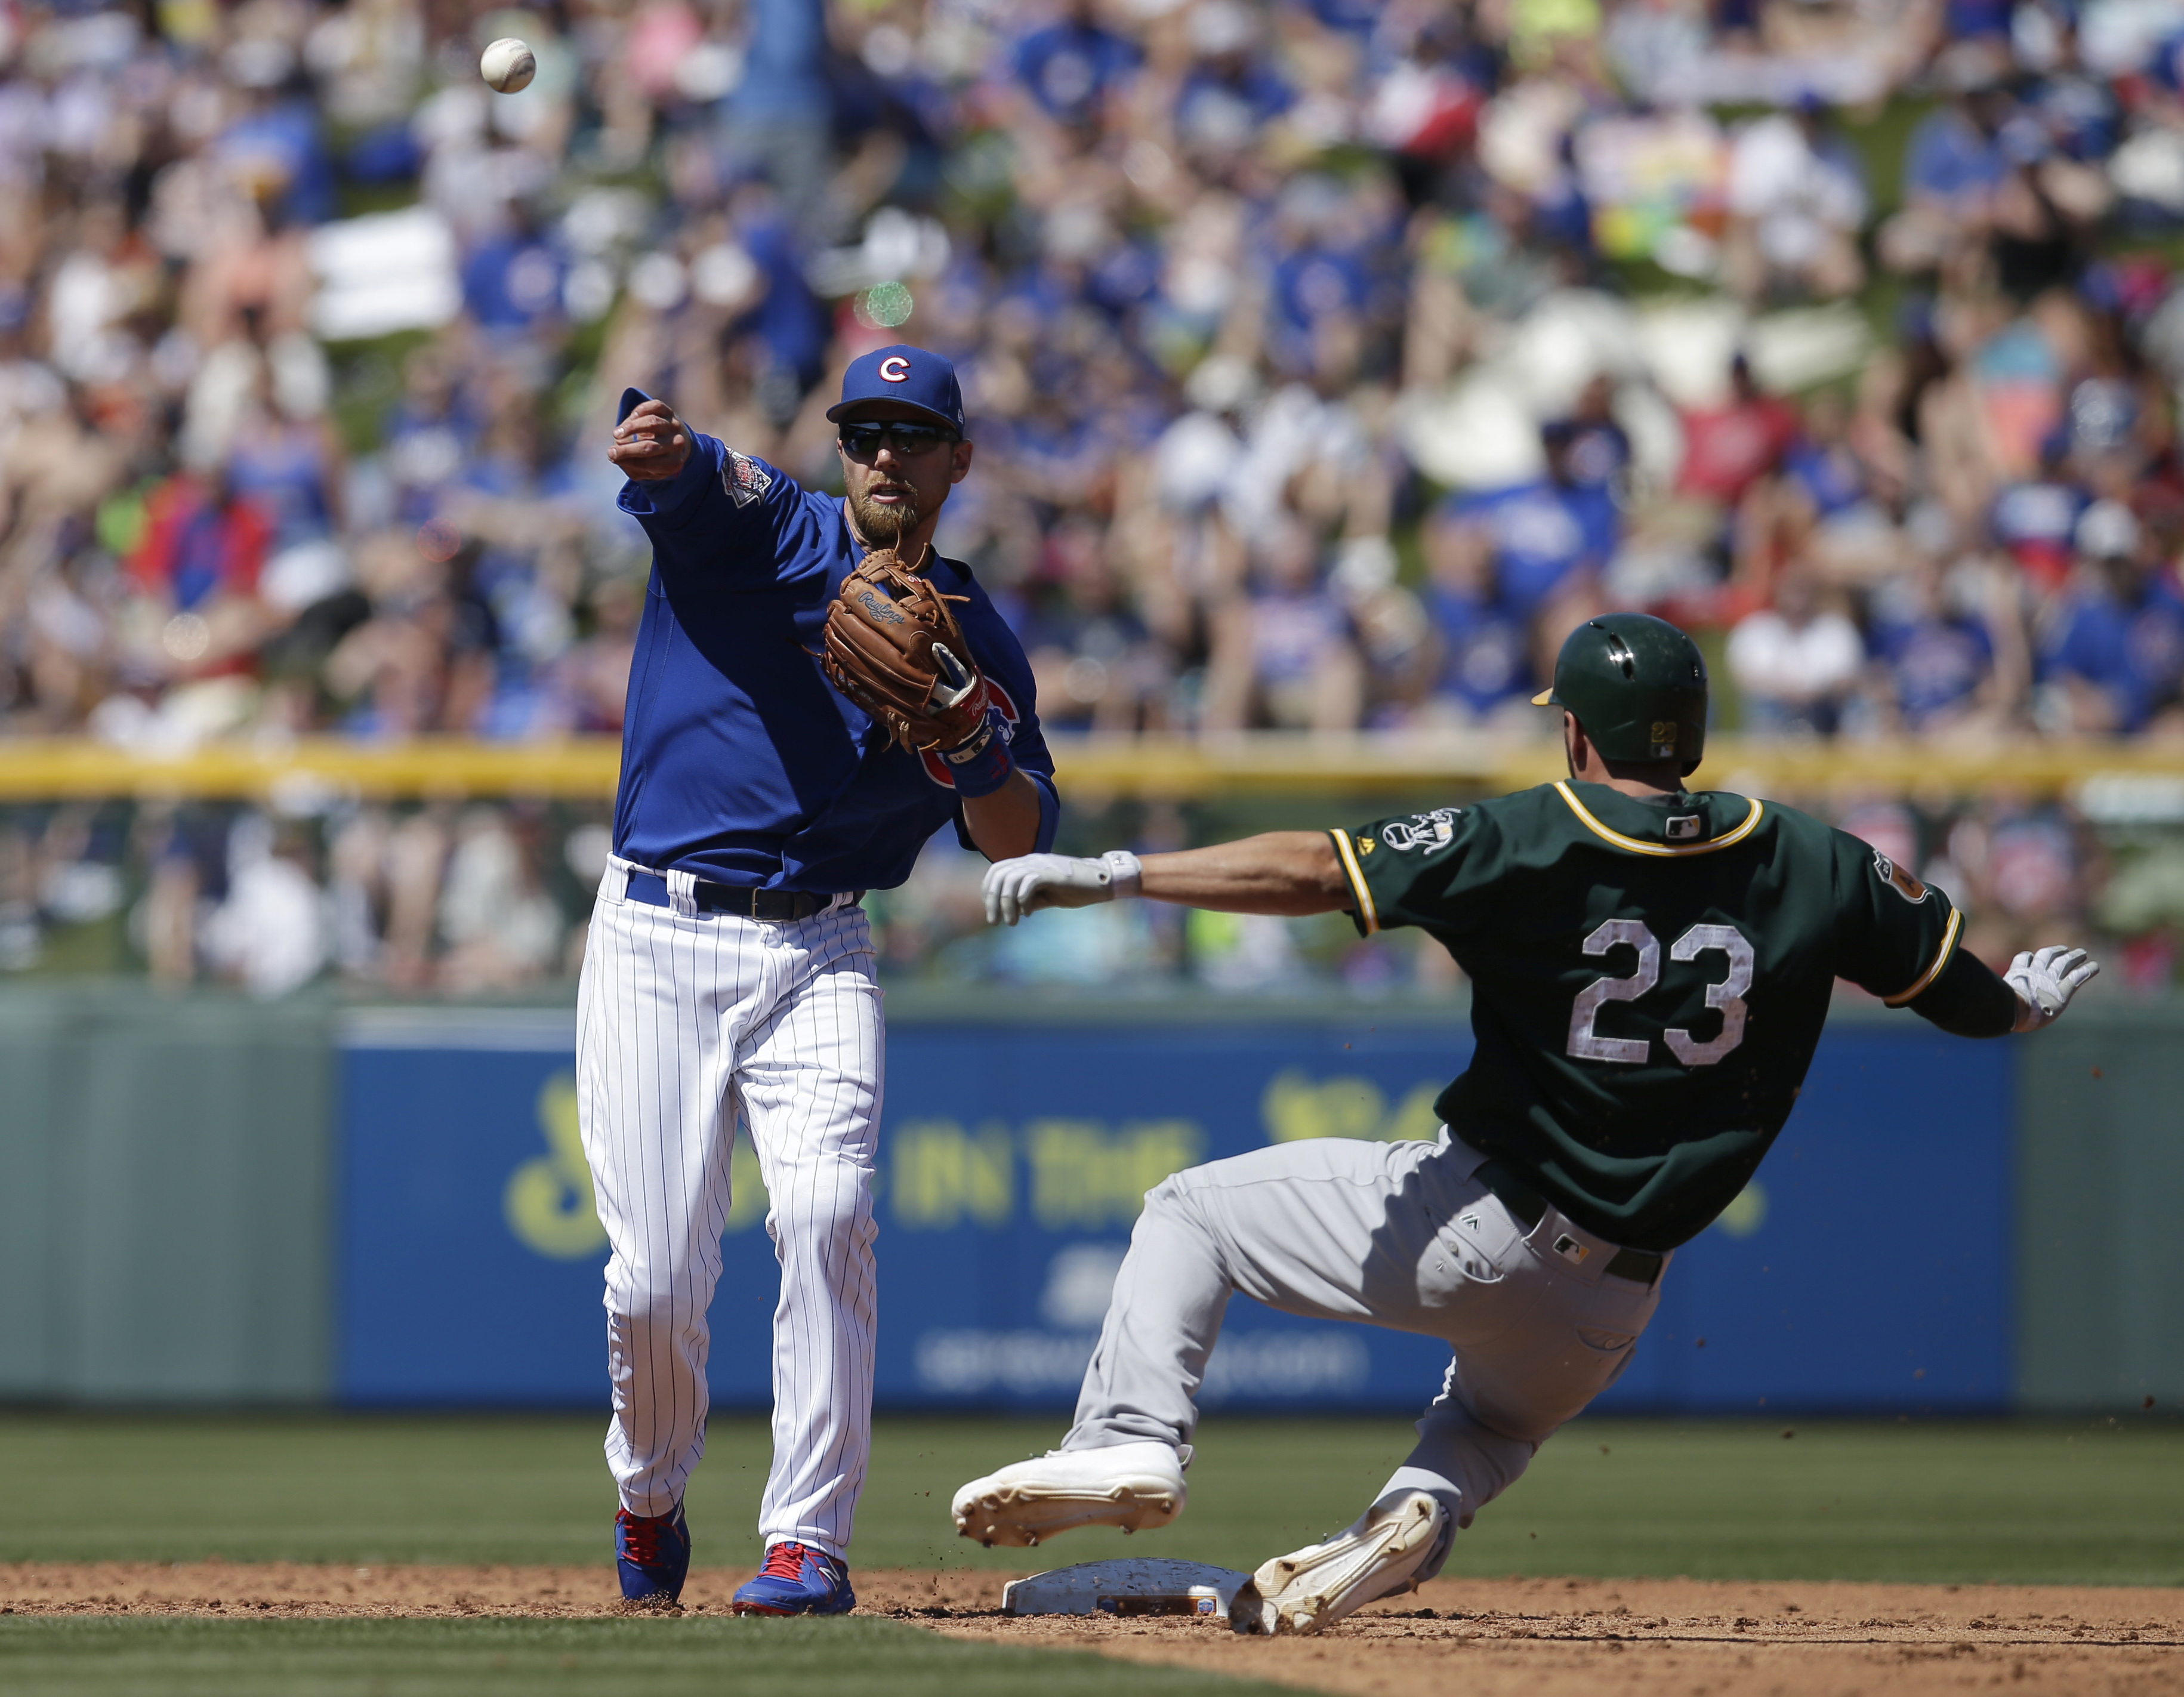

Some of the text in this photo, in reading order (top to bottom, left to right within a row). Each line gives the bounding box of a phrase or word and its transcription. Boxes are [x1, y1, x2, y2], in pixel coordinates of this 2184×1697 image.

[878, 355, 911, 382] C
[857, 591, 905, 625] Rawlings
[1566, 918, 1754, 1066] 23
[891, 1118, 1016, 1227] IN
